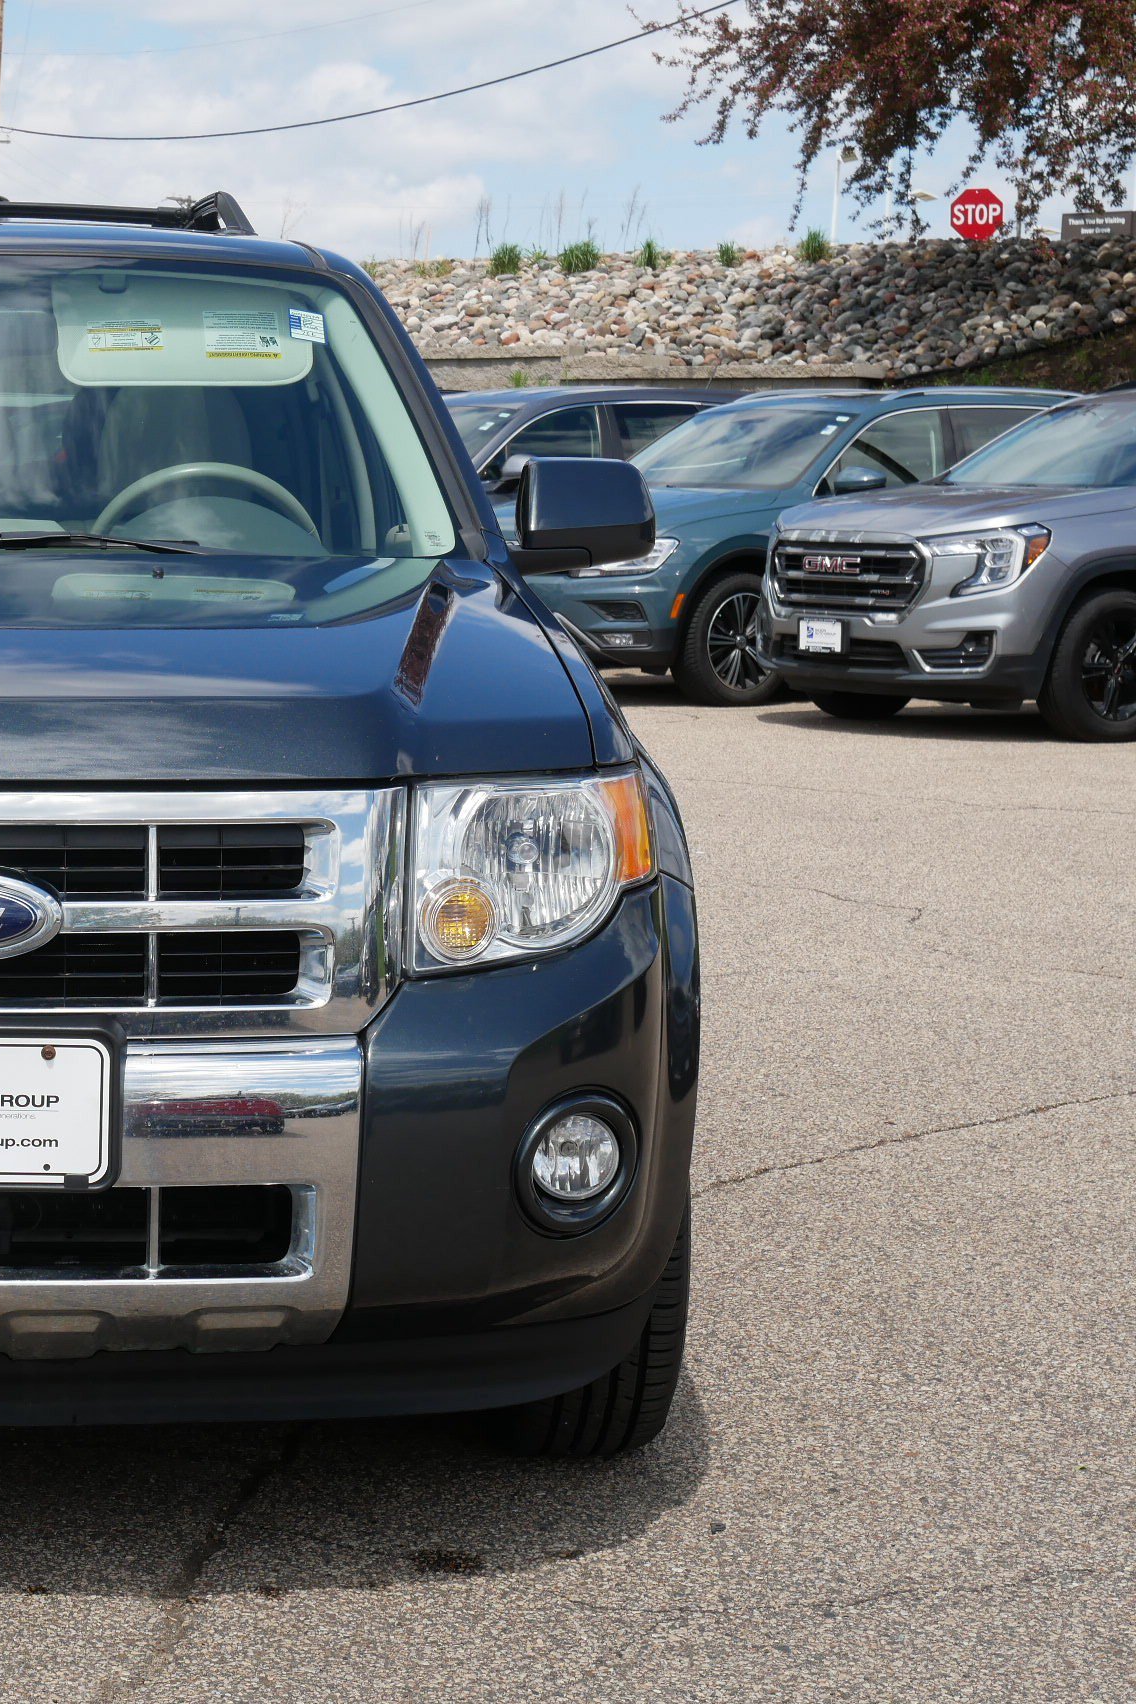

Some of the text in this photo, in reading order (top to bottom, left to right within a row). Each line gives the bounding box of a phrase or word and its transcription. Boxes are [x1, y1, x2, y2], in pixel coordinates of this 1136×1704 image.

[952, 203, 1001, 225] STOP
[1068, 218, 1085, 226] Thank
[1104, 216, 1126, 225] Visiting
[803, 555, 861, 574] GMC
